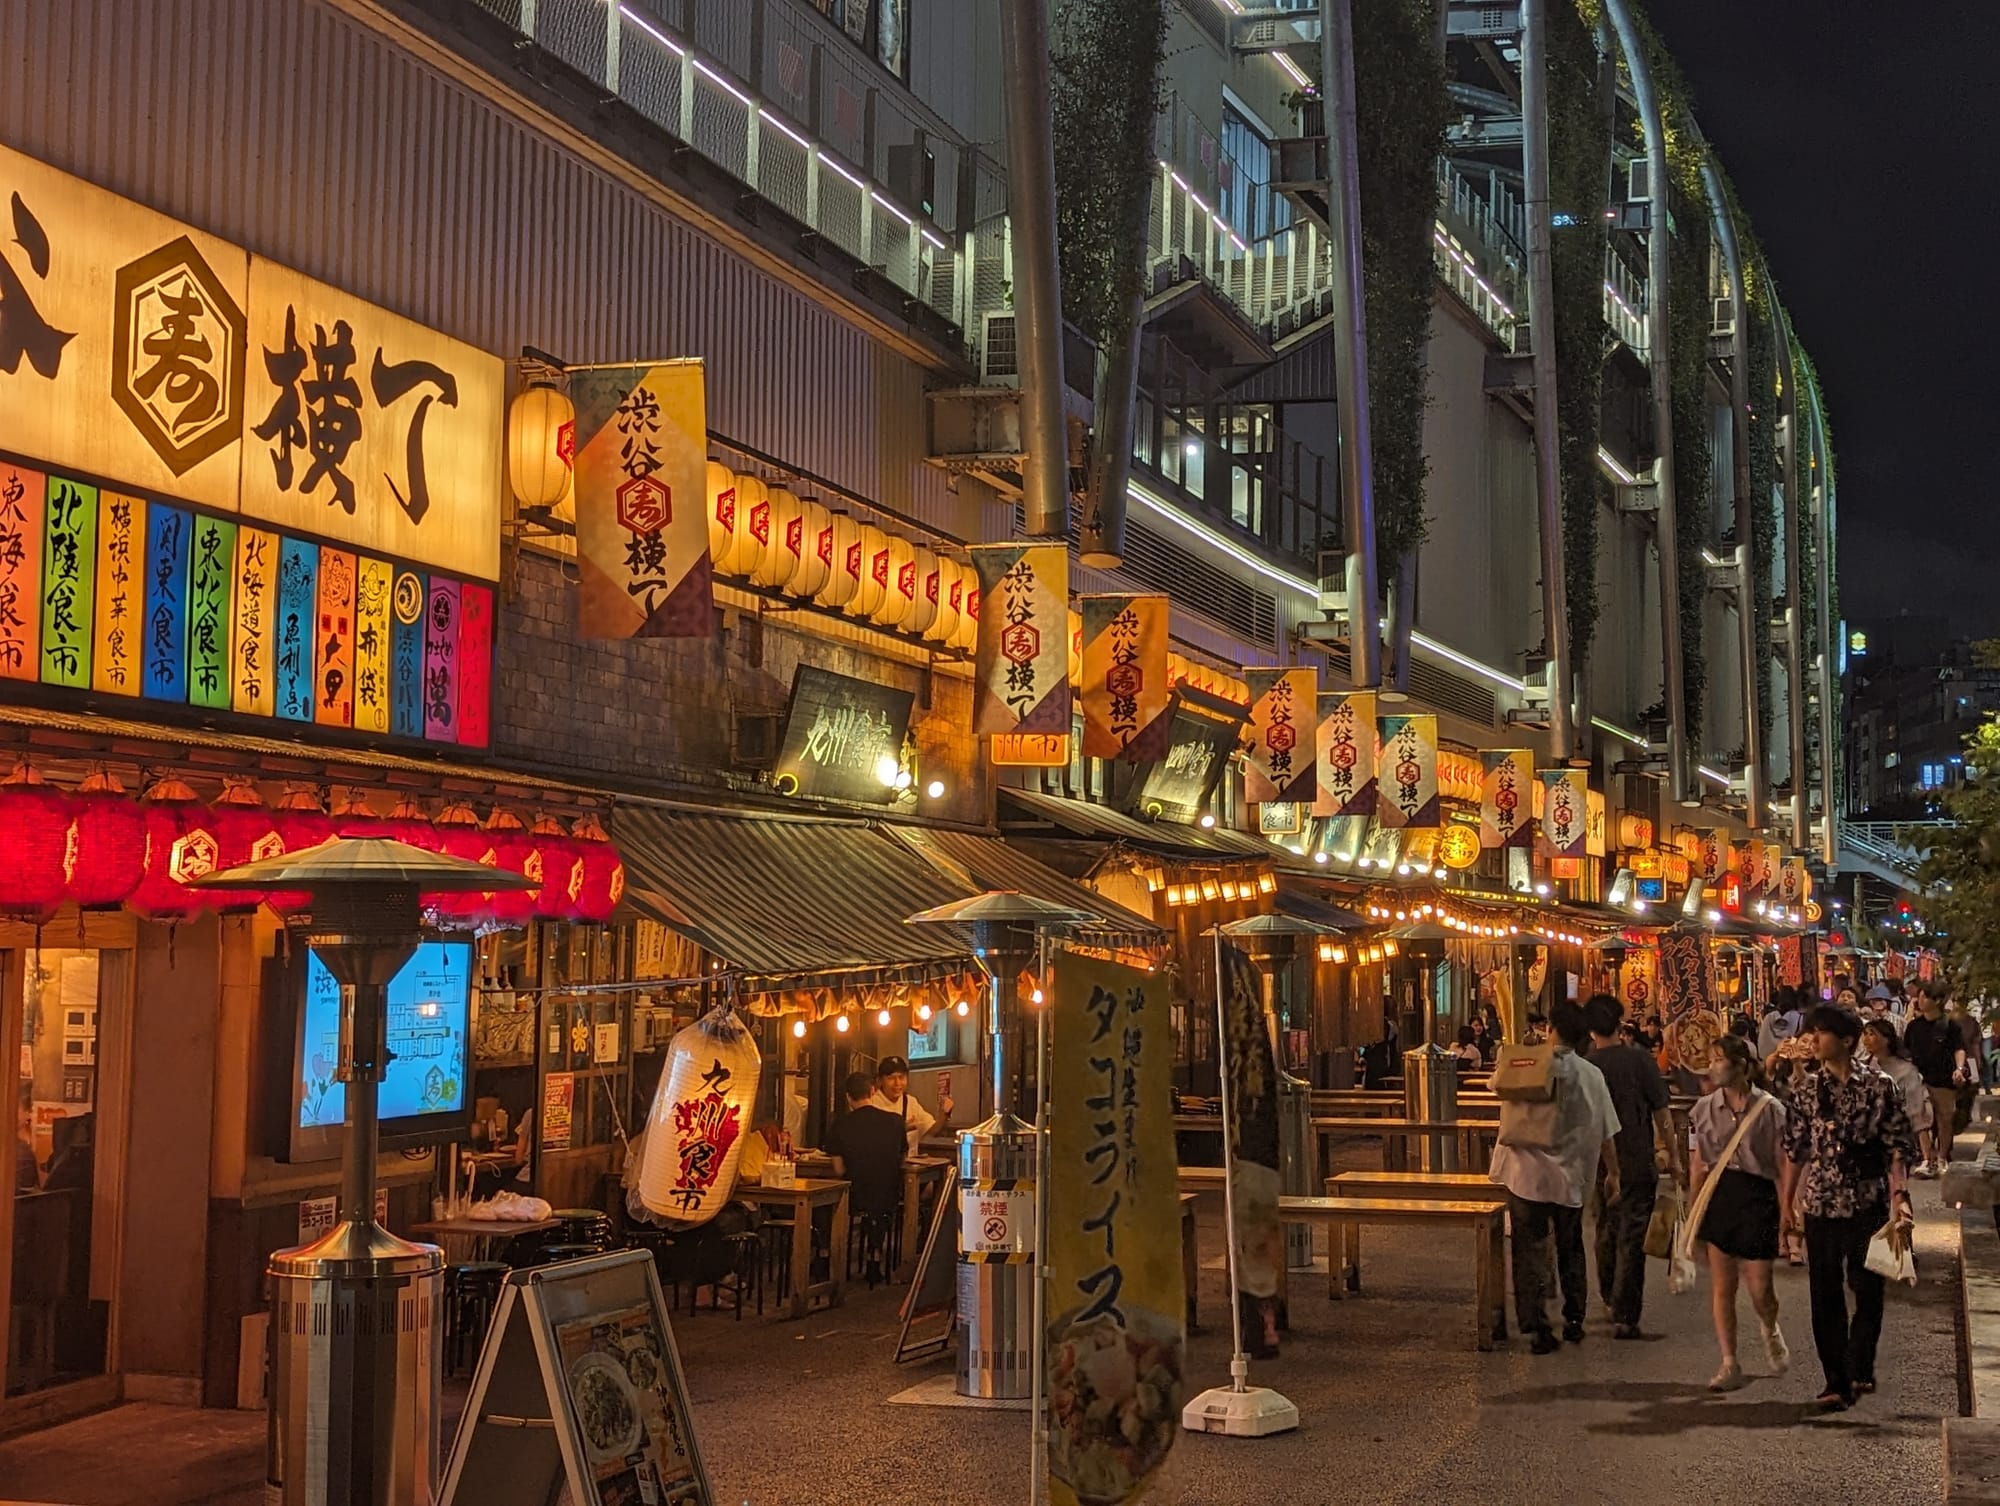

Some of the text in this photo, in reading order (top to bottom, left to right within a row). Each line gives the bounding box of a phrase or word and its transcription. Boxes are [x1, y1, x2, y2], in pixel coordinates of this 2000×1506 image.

[0, 471, 28, 673] 東海食市
[46, 484, 84, 684] 北陸食市
[106, 498, 131, 688] 横浜中華食市
[151, 512, 182, 693] 関東食市
[194, 522, 224, 704] 東北食市
[240, 533, 268, 705] 北海道食市
[358, 622, 378, 707] 布袋
[398, 628, 414, 733] 渋谷バル
[1662, 937, 1688, 1015] ラーメン
[1678, 935, 1706, 1020] スタミナ
[669, 1058, 735, 1215] 九州食市
[980, 1201, 1008, 1216] 禁煙
[1073, 985, 1125, 1330] タコライス
